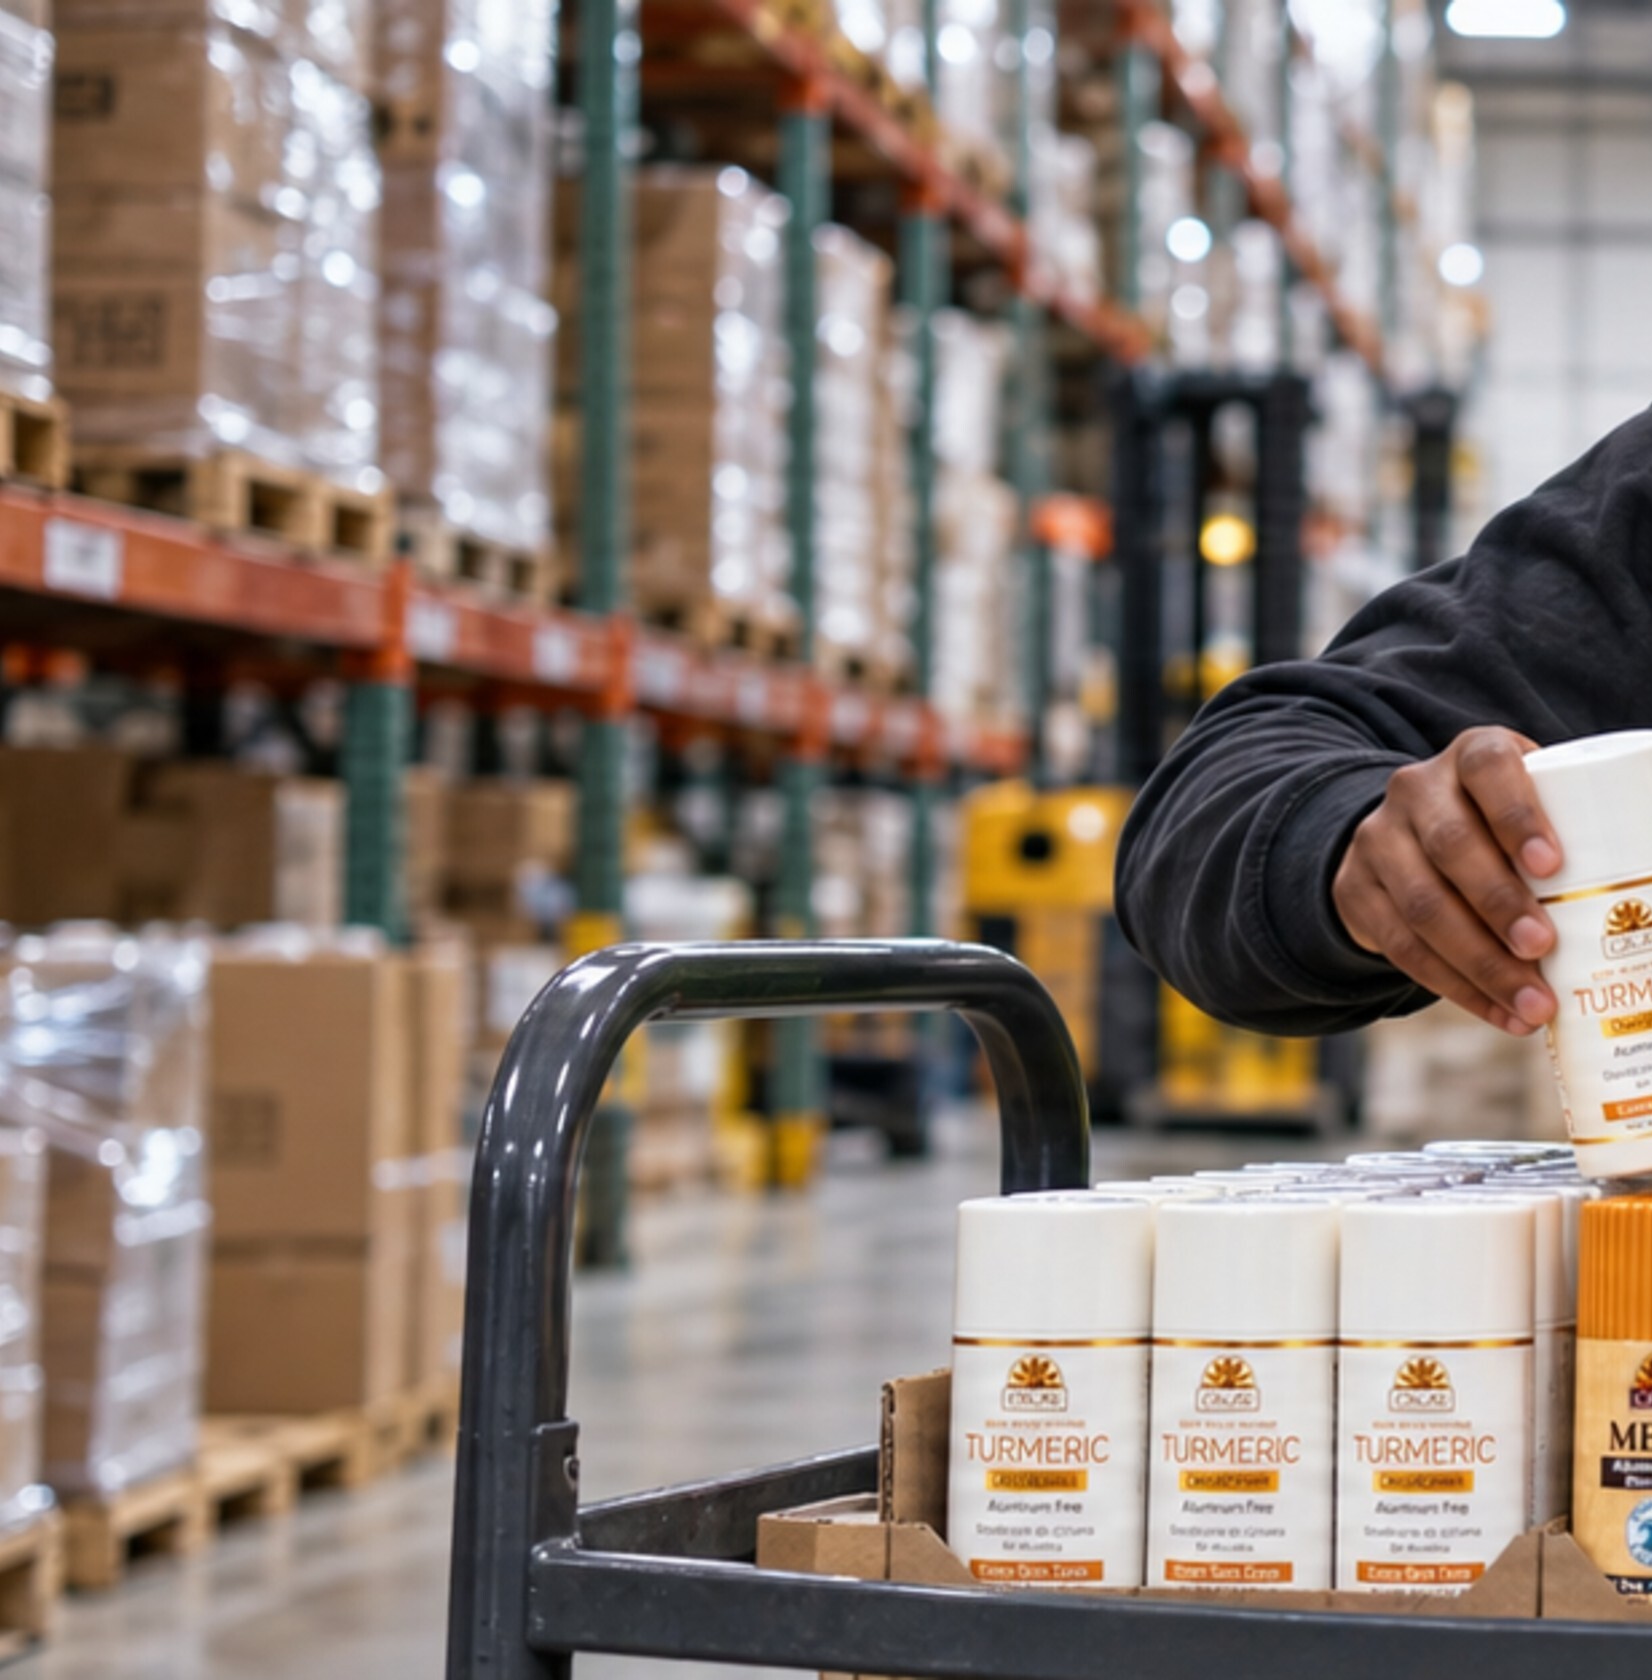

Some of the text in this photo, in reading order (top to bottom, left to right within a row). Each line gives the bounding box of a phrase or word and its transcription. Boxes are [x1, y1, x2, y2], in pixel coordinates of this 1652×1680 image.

[965, 1433, 1110, 1464] TURMERIC
[1162, 1433, 1301, 1464] TURMERIC
[1354, 1434, 1496, 1464] TURMERIC
